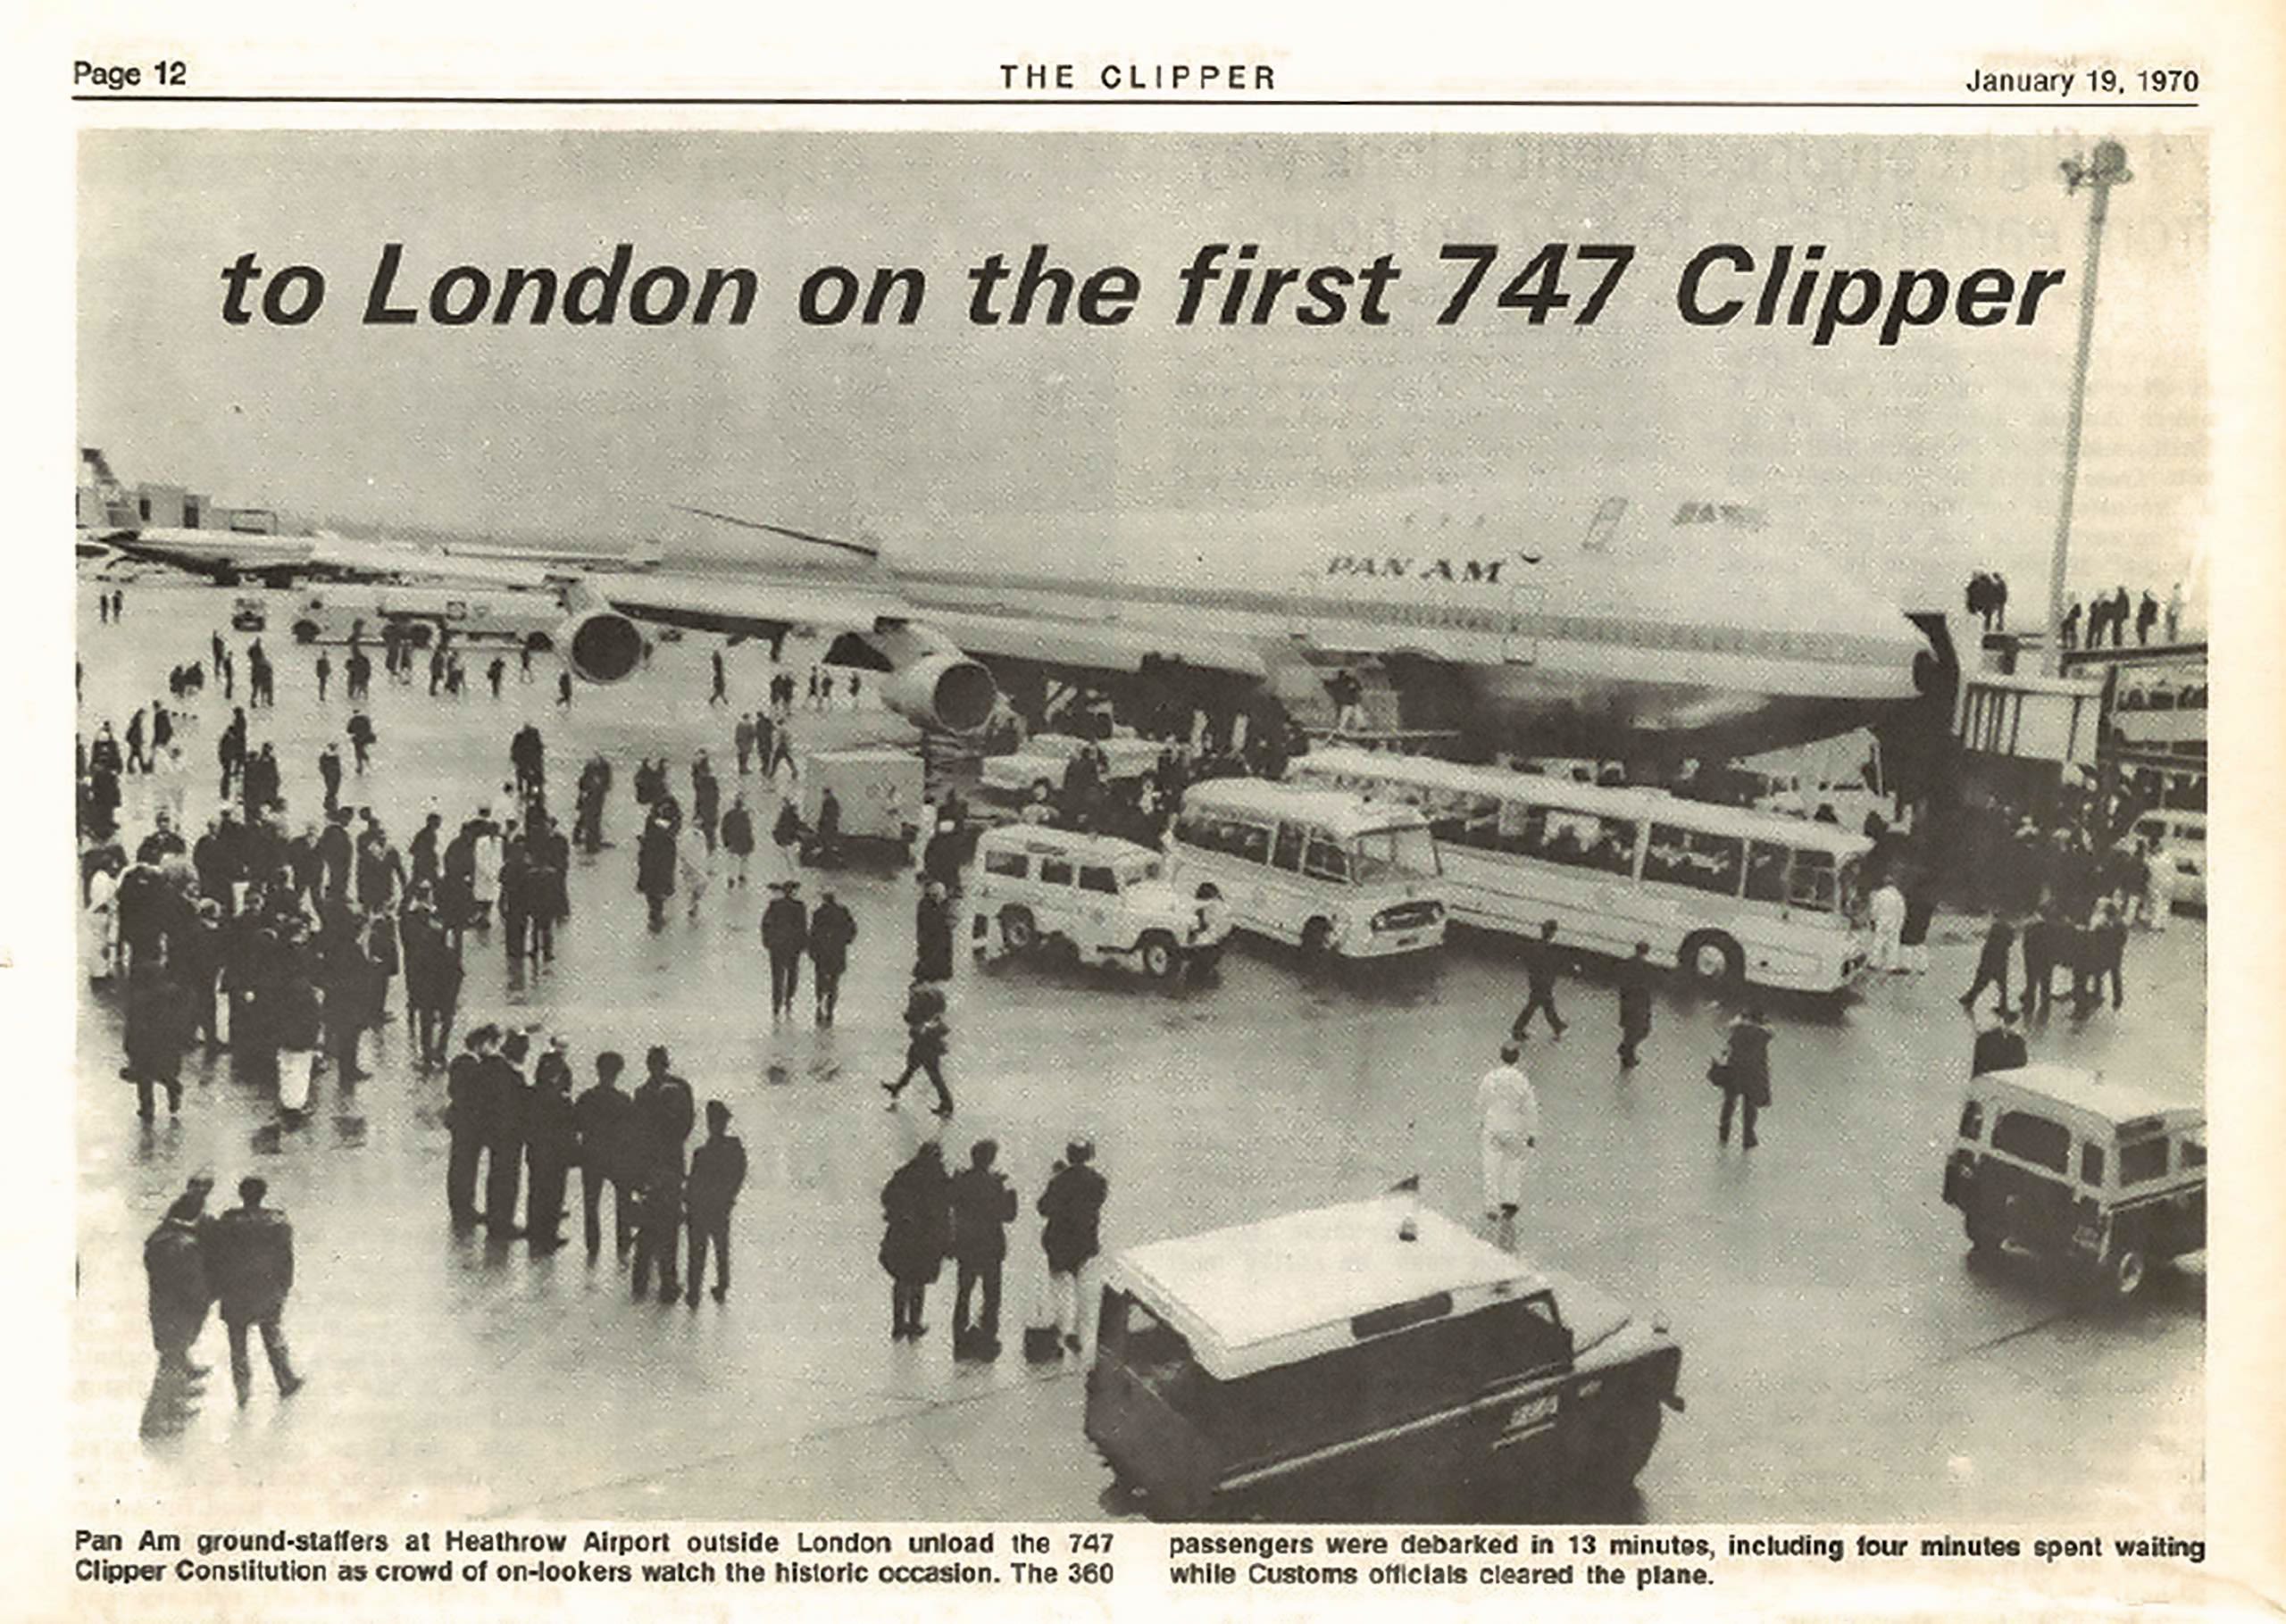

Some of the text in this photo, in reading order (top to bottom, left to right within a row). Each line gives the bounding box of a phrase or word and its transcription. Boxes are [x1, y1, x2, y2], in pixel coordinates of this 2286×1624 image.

[74, 60, 187, 90] Page 12
[1000, 63, 1274, 90] THE CLIPPER
[1965, 69, 2199, 97] January 19, 1970
[221, 244, 2065, 346] to London on the first 747 Clipper
[1326, 555, 1506, 584] PAN AM
[75, 1529, 1114, 1556] Pan Am ground-staffers at Heathrow Airport outside London unload the 747
[1170, 1534, 2206, 1563] passengers were debarked in 13 minutes, including four minutes spent waiting
[75, 1558, 1114, 1585] Clipper Constitution as crowd of on-lookers watch the historic occasion. The 360
[1170, 1562, 1714, 1591] while Customs officials cleared the plane.
